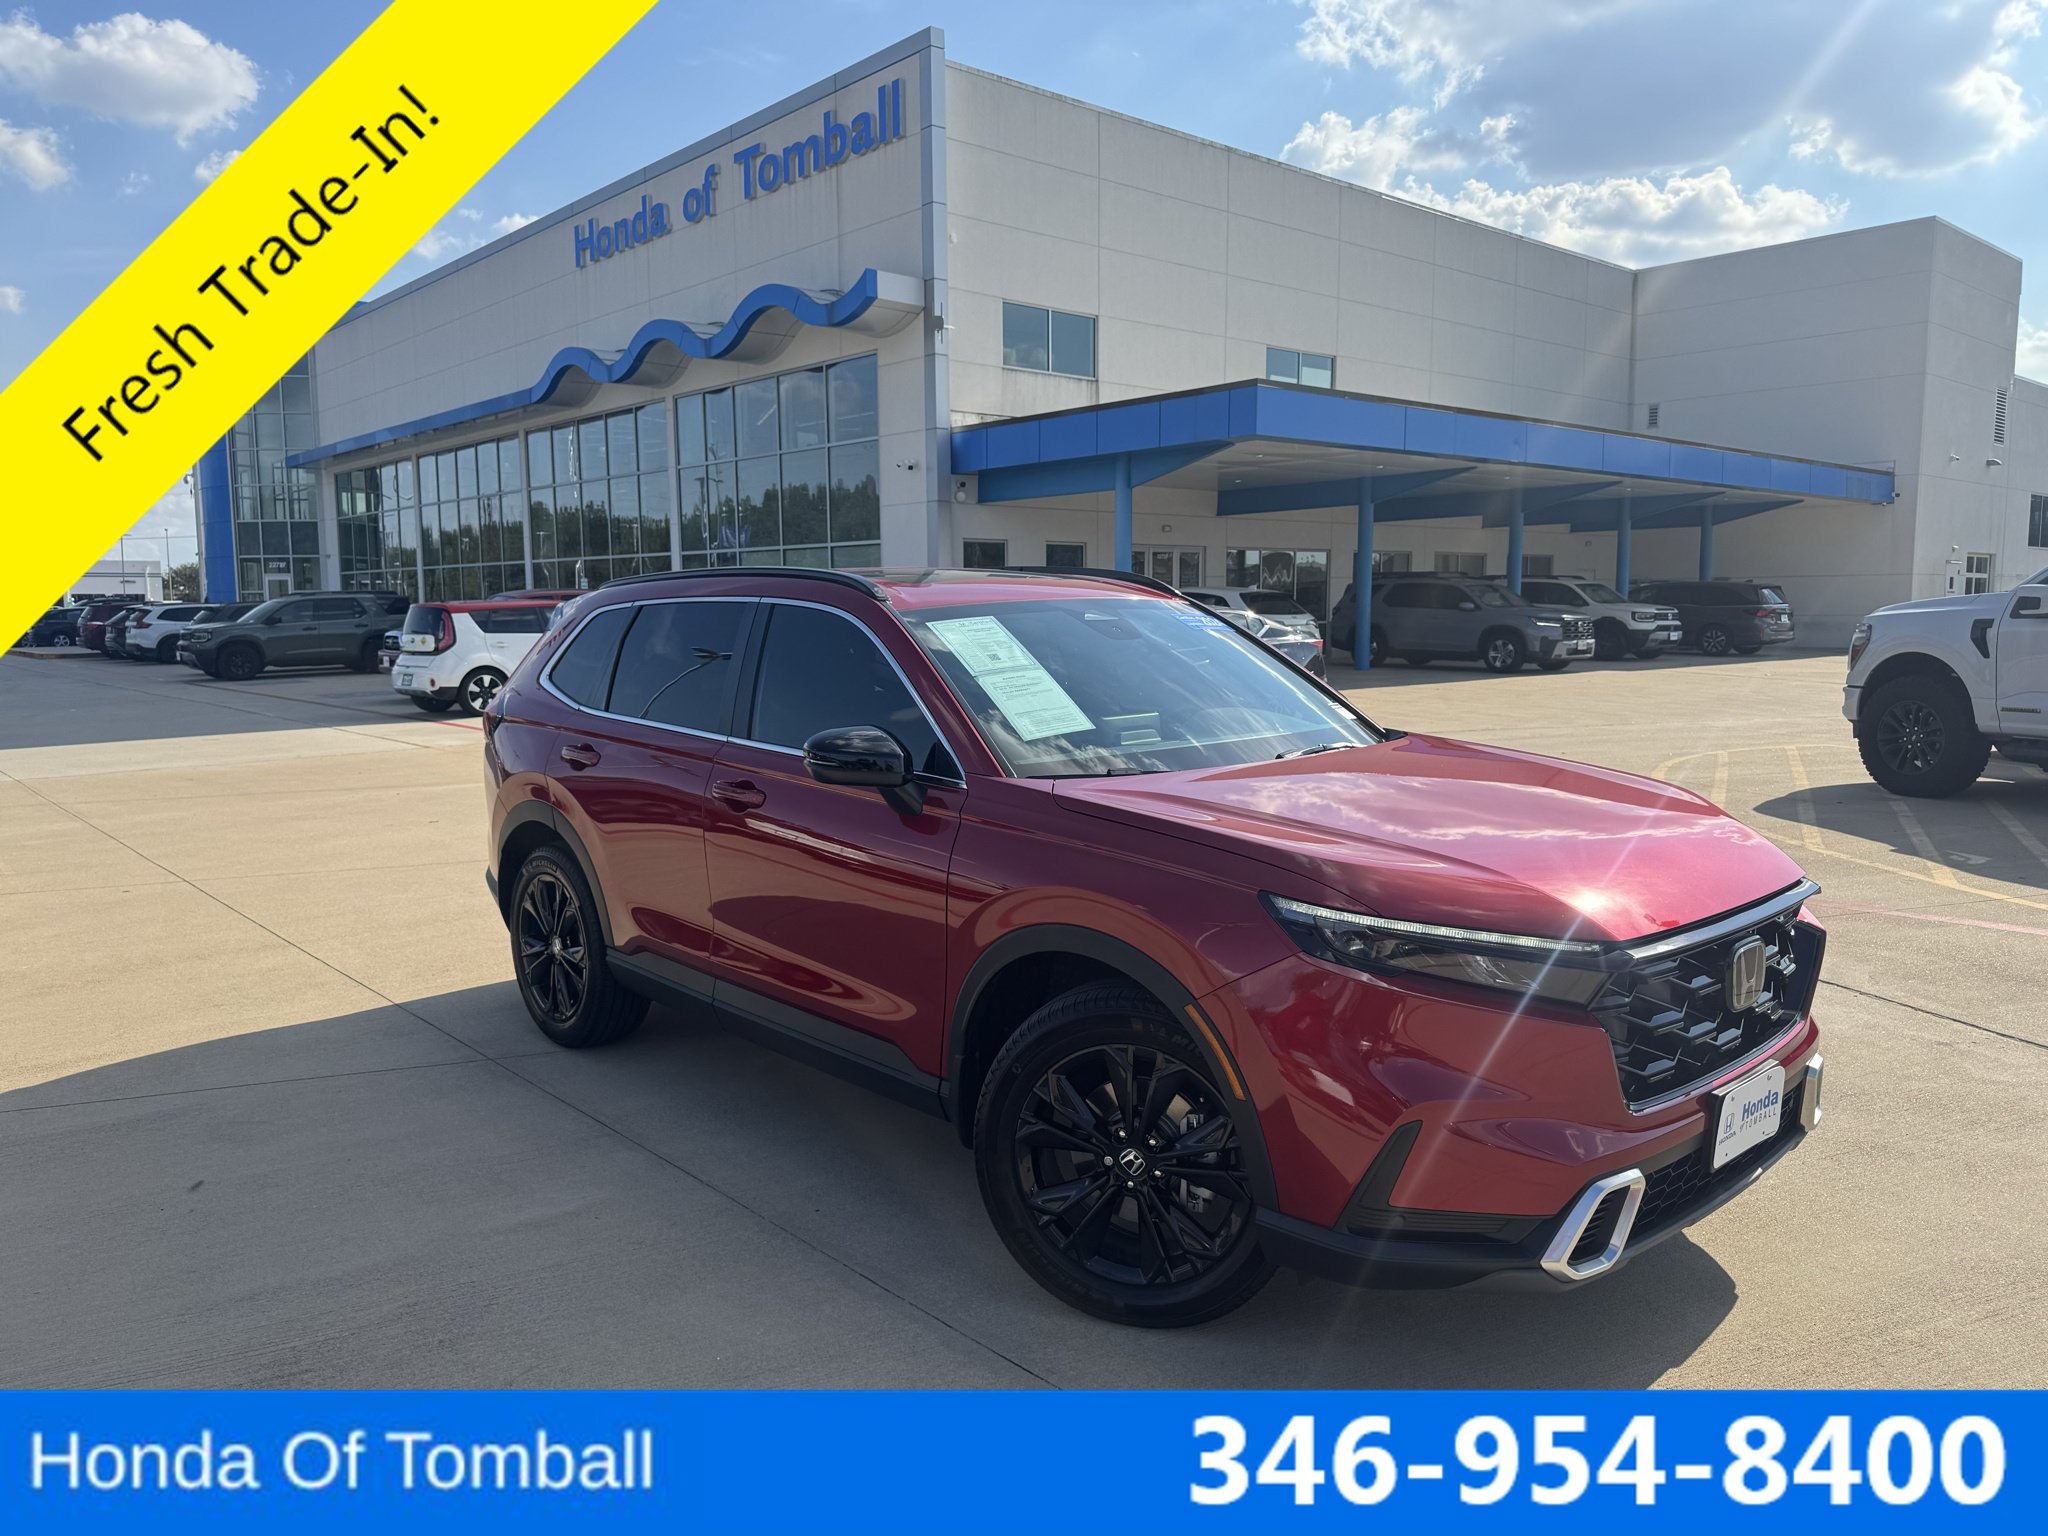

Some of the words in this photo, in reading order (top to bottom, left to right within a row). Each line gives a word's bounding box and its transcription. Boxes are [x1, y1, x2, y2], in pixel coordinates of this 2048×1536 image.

[574, 195, 670, 268] Honda
[683, 164, 719, 223] of
[734, 78, 906, 200] Tomball
[1741, 1089, 1779, 1122] Honda
[1745, 1106, 1777, 1130] TOMBALL
